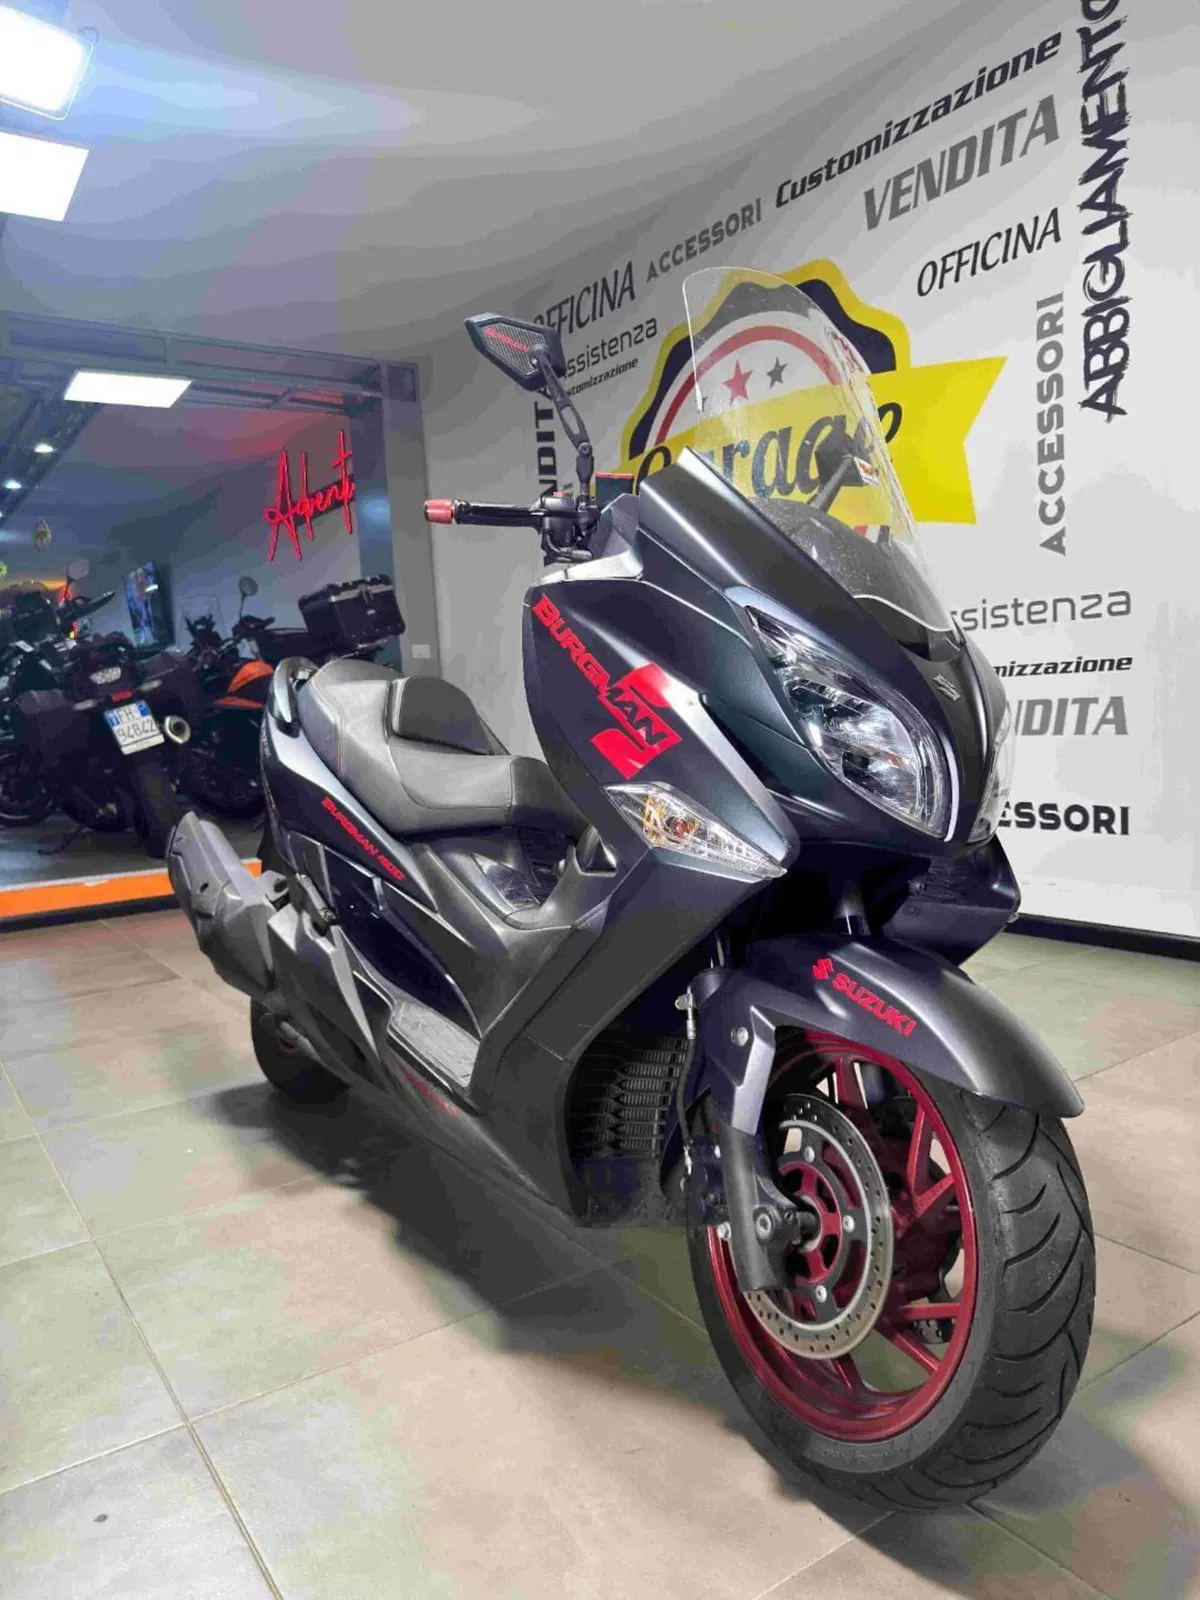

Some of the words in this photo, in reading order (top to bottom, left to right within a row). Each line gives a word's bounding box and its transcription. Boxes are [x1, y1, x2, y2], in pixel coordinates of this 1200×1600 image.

[775, 31, 1062, 209] Customizzazione
[863, 94, 1060, 232] VENDITA
[645, 197, 762, 283] ACCESSORI
[916, 207, 1062, 299] OFFICINA
[564, 317, 659, 380] ssistenza
[1035, 290, 1067, 558] ACCESSORI
[950, 590, 1132, 632] sistenza
[530, 592, 668, 748] BURGMAN
[832, 972, 917, 1038] SUZUKI
